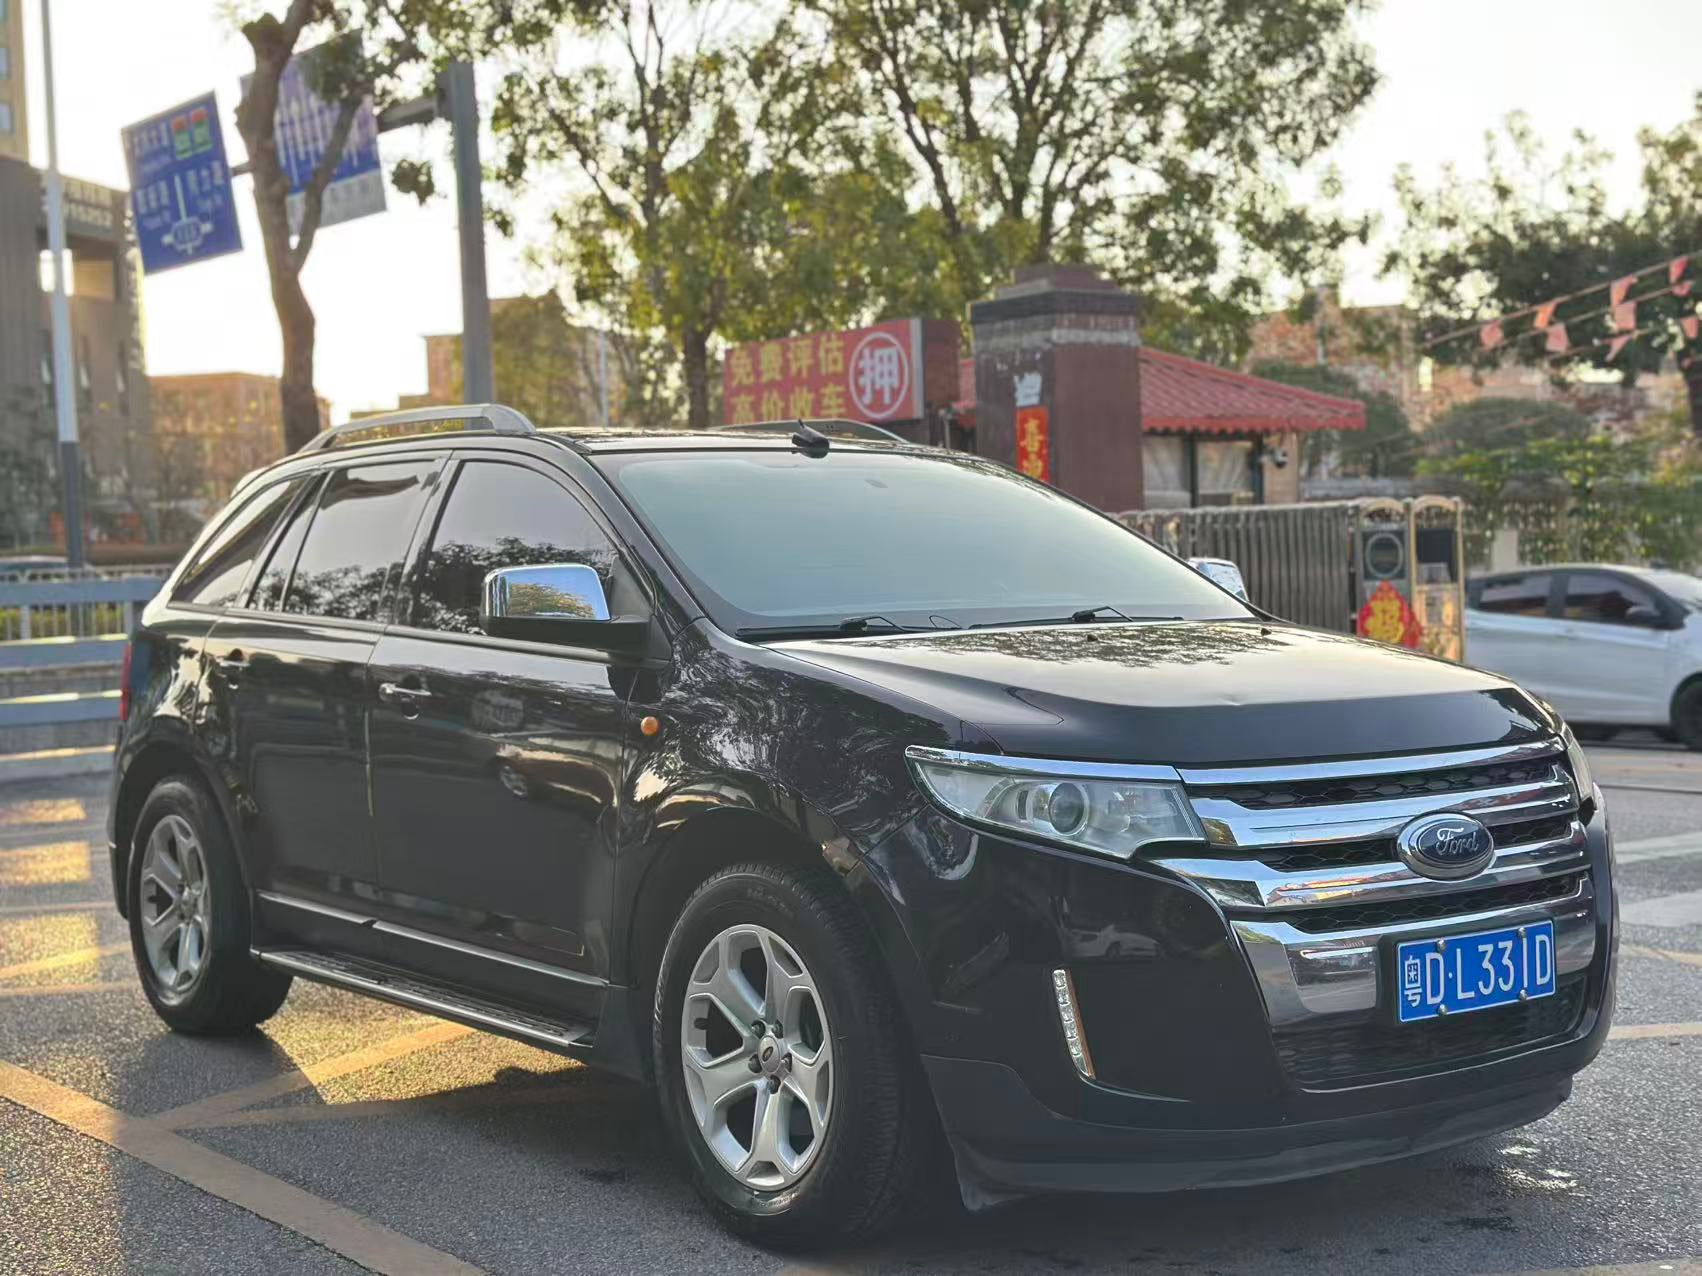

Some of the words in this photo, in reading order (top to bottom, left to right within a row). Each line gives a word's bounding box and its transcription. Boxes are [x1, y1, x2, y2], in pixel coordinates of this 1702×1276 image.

[730, 334, 844, 387] 免费评估
[858, 347, 899, 405] 押
[730, 382, 847, 424] 高价收车
[1435, 827, 1479, 856] Ford
